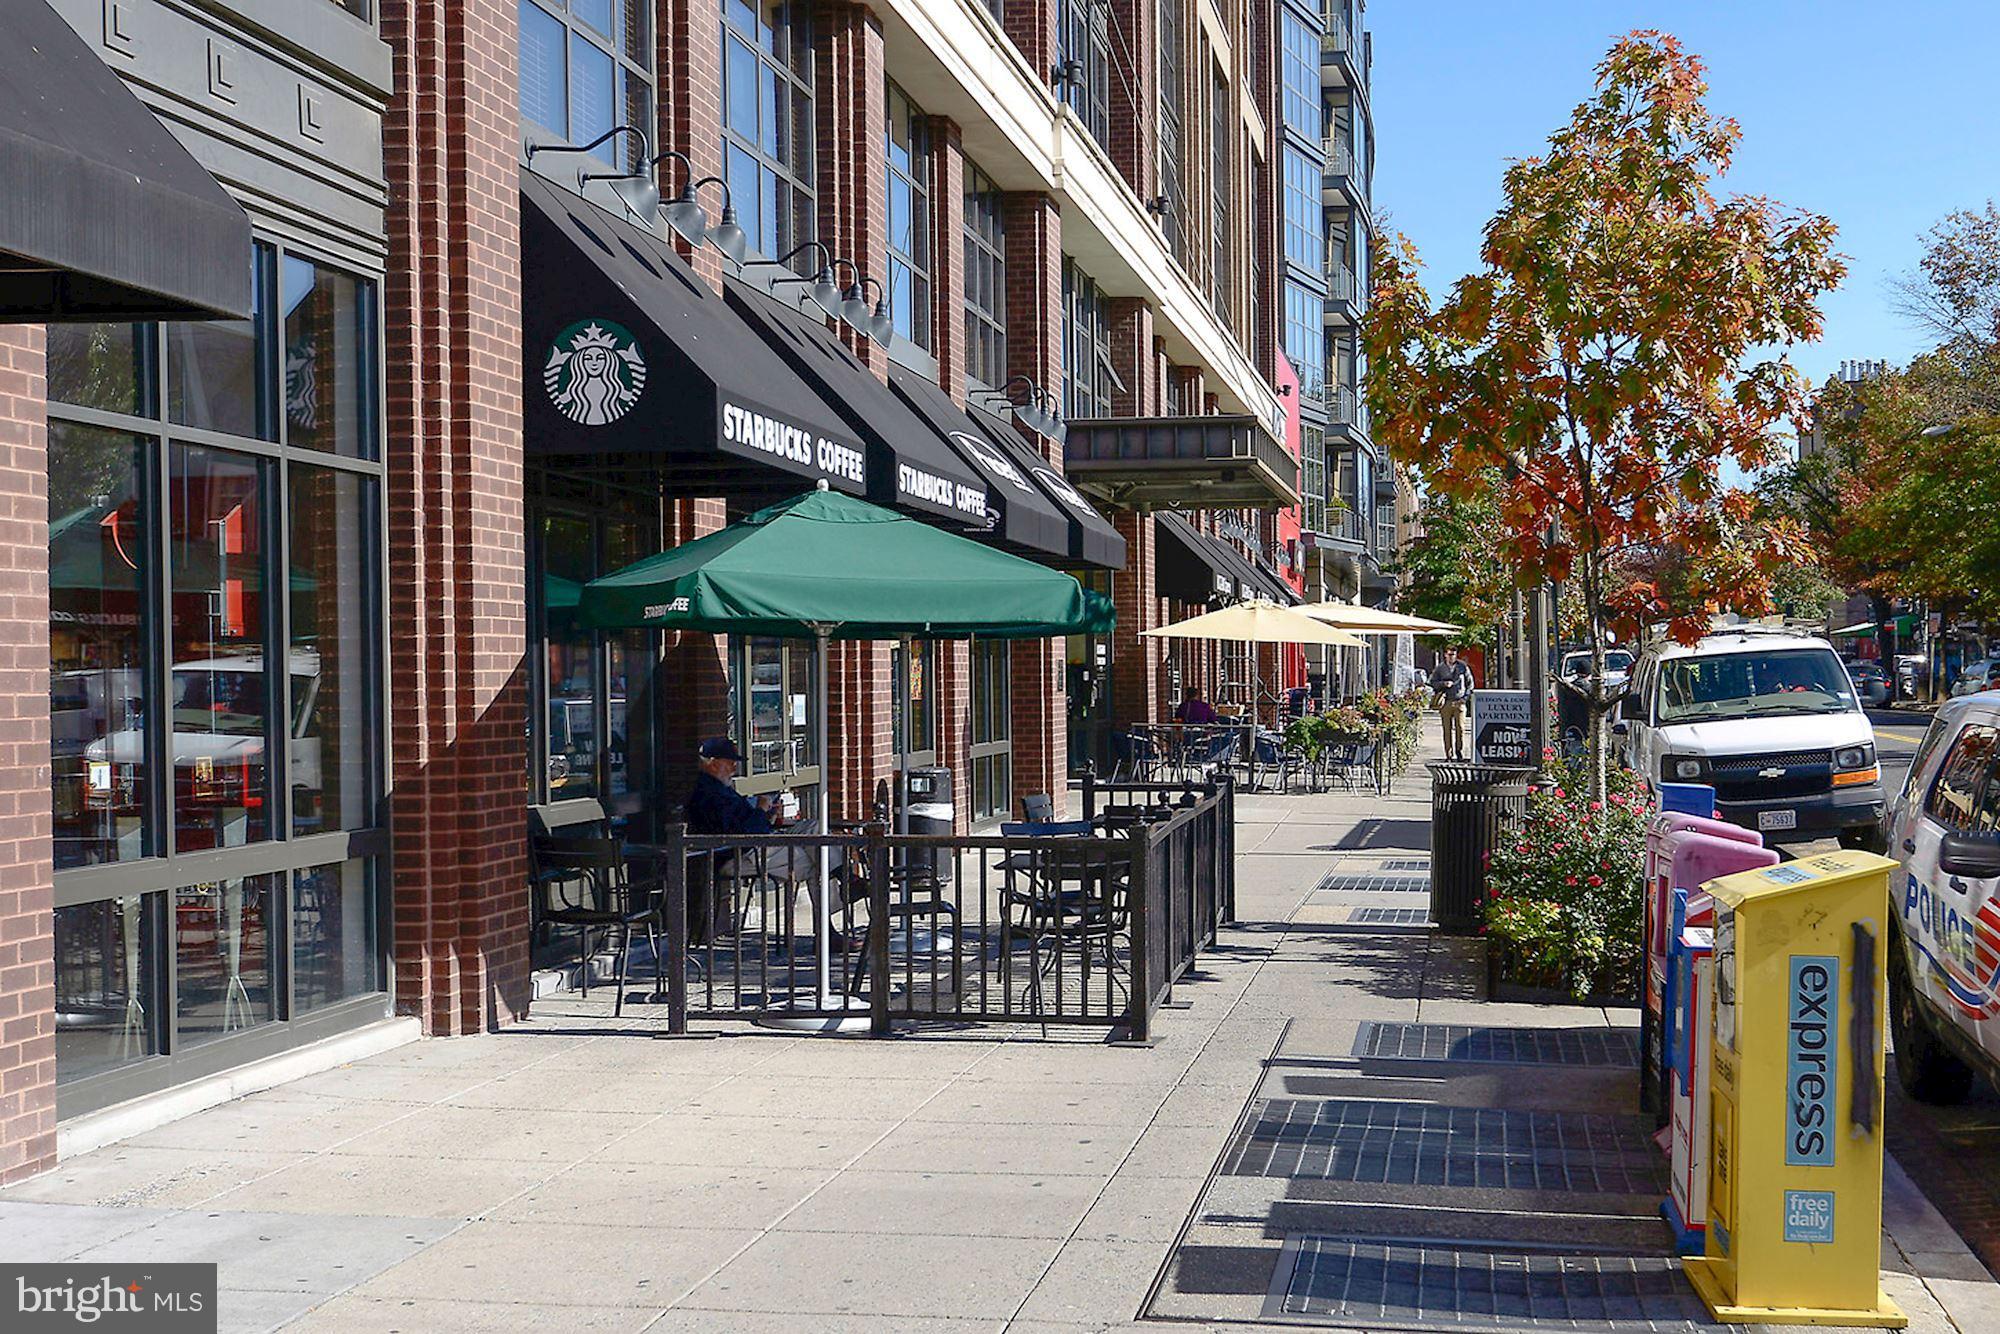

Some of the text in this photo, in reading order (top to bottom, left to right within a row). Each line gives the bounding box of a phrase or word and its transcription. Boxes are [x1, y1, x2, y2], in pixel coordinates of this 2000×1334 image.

[723, 402, 865, 483] STARBUCKS COFFEE
[899, 463, 953, 507] STARBUCKS
[955, 483, 987, 517] COFFEE
[1904, 873, 1975, 976] POLICE
[1790, 964, 1828, 1156] express
[1788, 1211, 1829, 1229] daily
[1789, 1194, 1828, 1211] free
